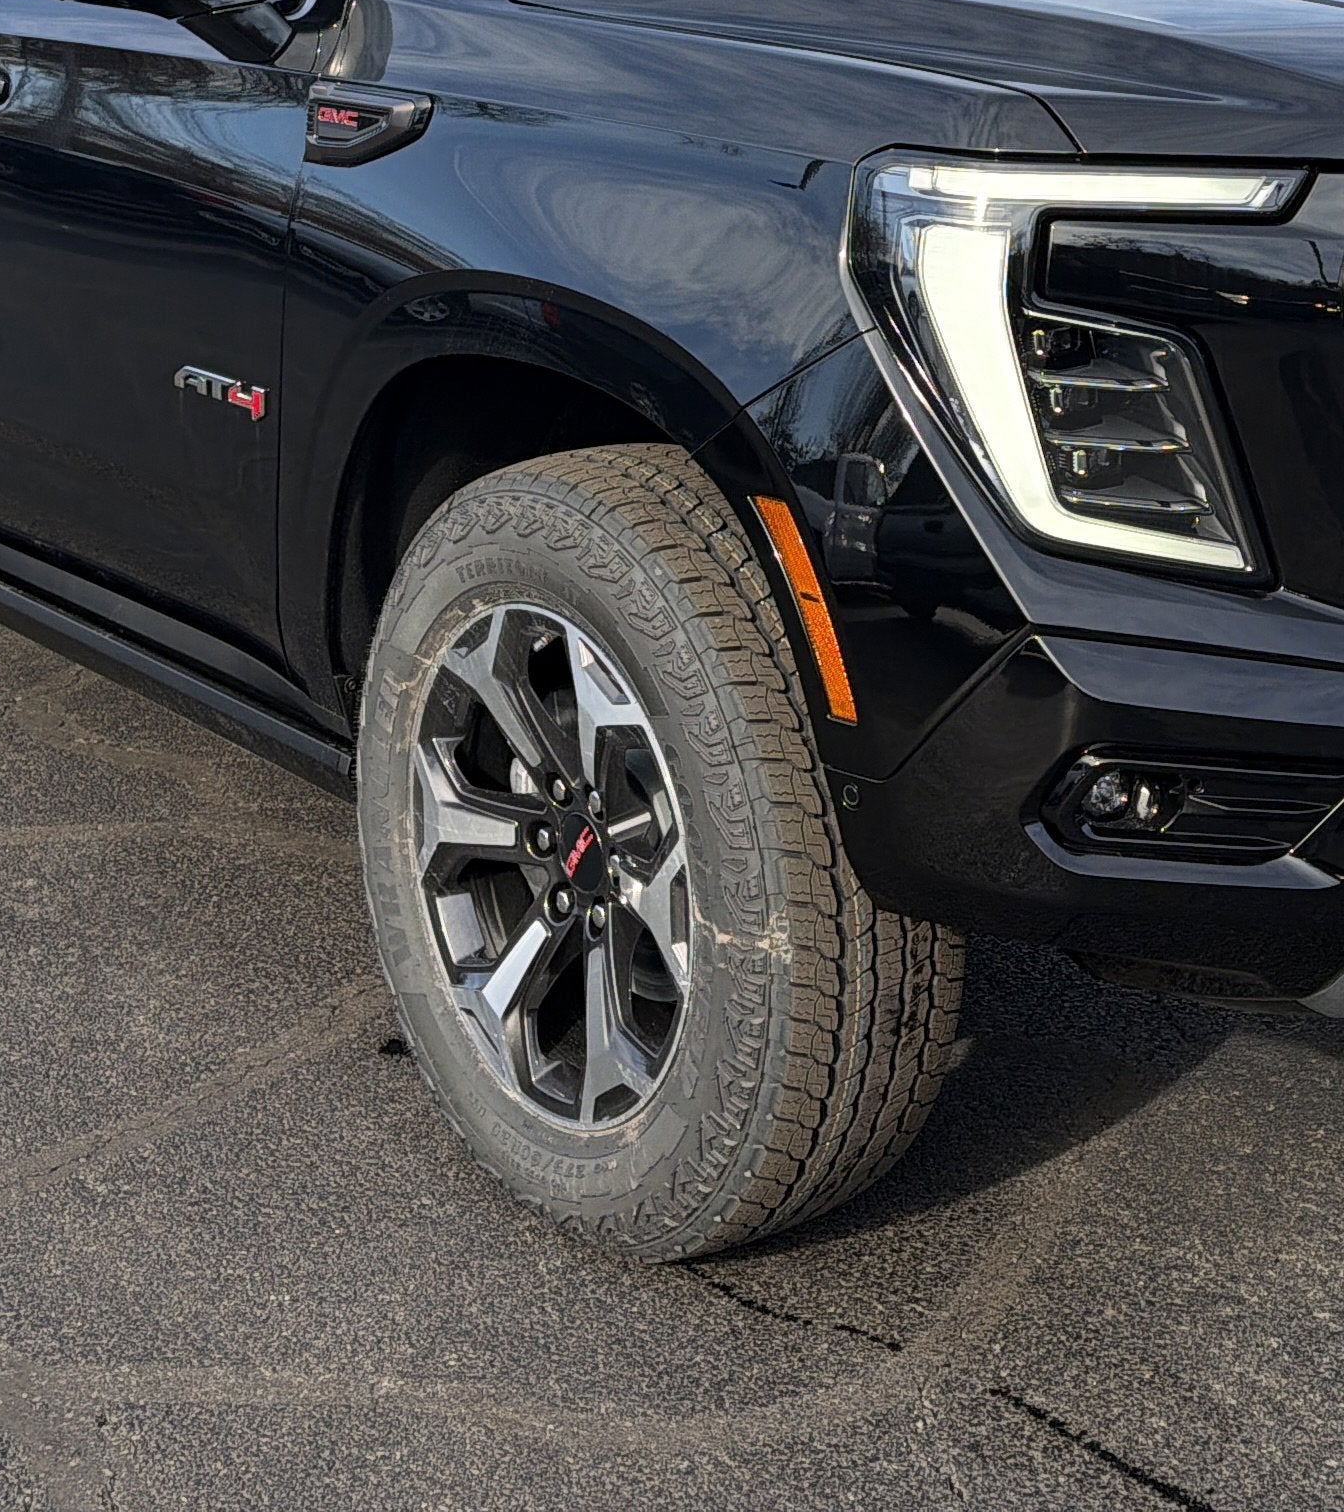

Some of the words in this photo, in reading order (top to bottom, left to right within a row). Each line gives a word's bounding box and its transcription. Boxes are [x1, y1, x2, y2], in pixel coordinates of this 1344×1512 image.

[318, 107, 359, 128] GMC
[174, 365, 265, 422] AT4
[565, 825, 594, 879] GMC
